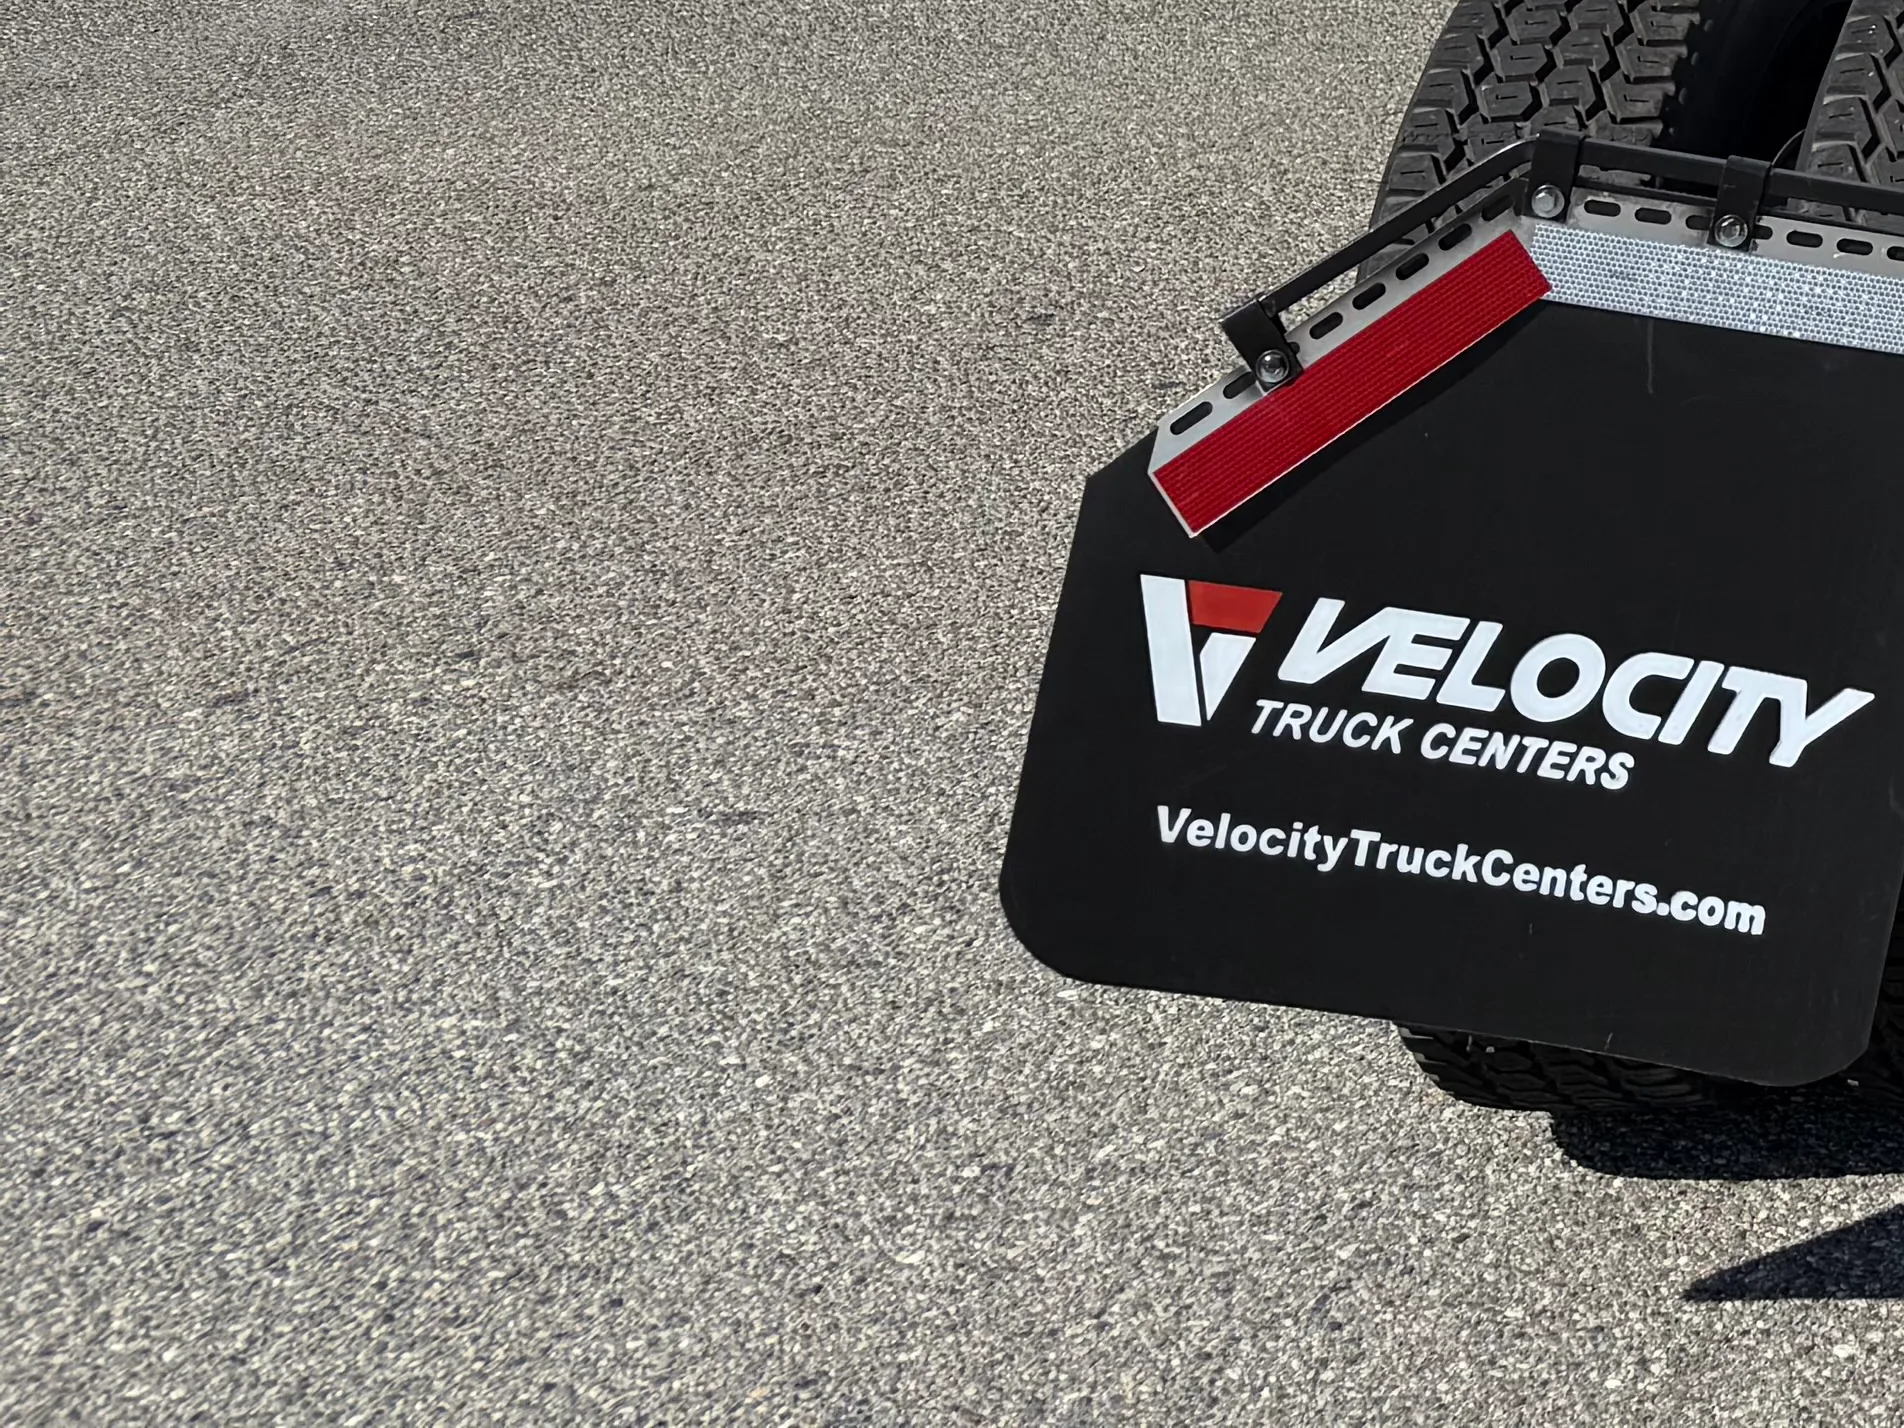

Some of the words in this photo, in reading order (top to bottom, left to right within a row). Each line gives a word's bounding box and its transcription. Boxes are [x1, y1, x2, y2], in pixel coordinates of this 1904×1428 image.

[1251, 698, 1415, 755] TRUCK
[1421, 722, 1636, 791] CENTERS
[1278, 597, 1876, 768] VELOCITY
[1157, 805, 1767, 937] VelocityTruckCenters.com
